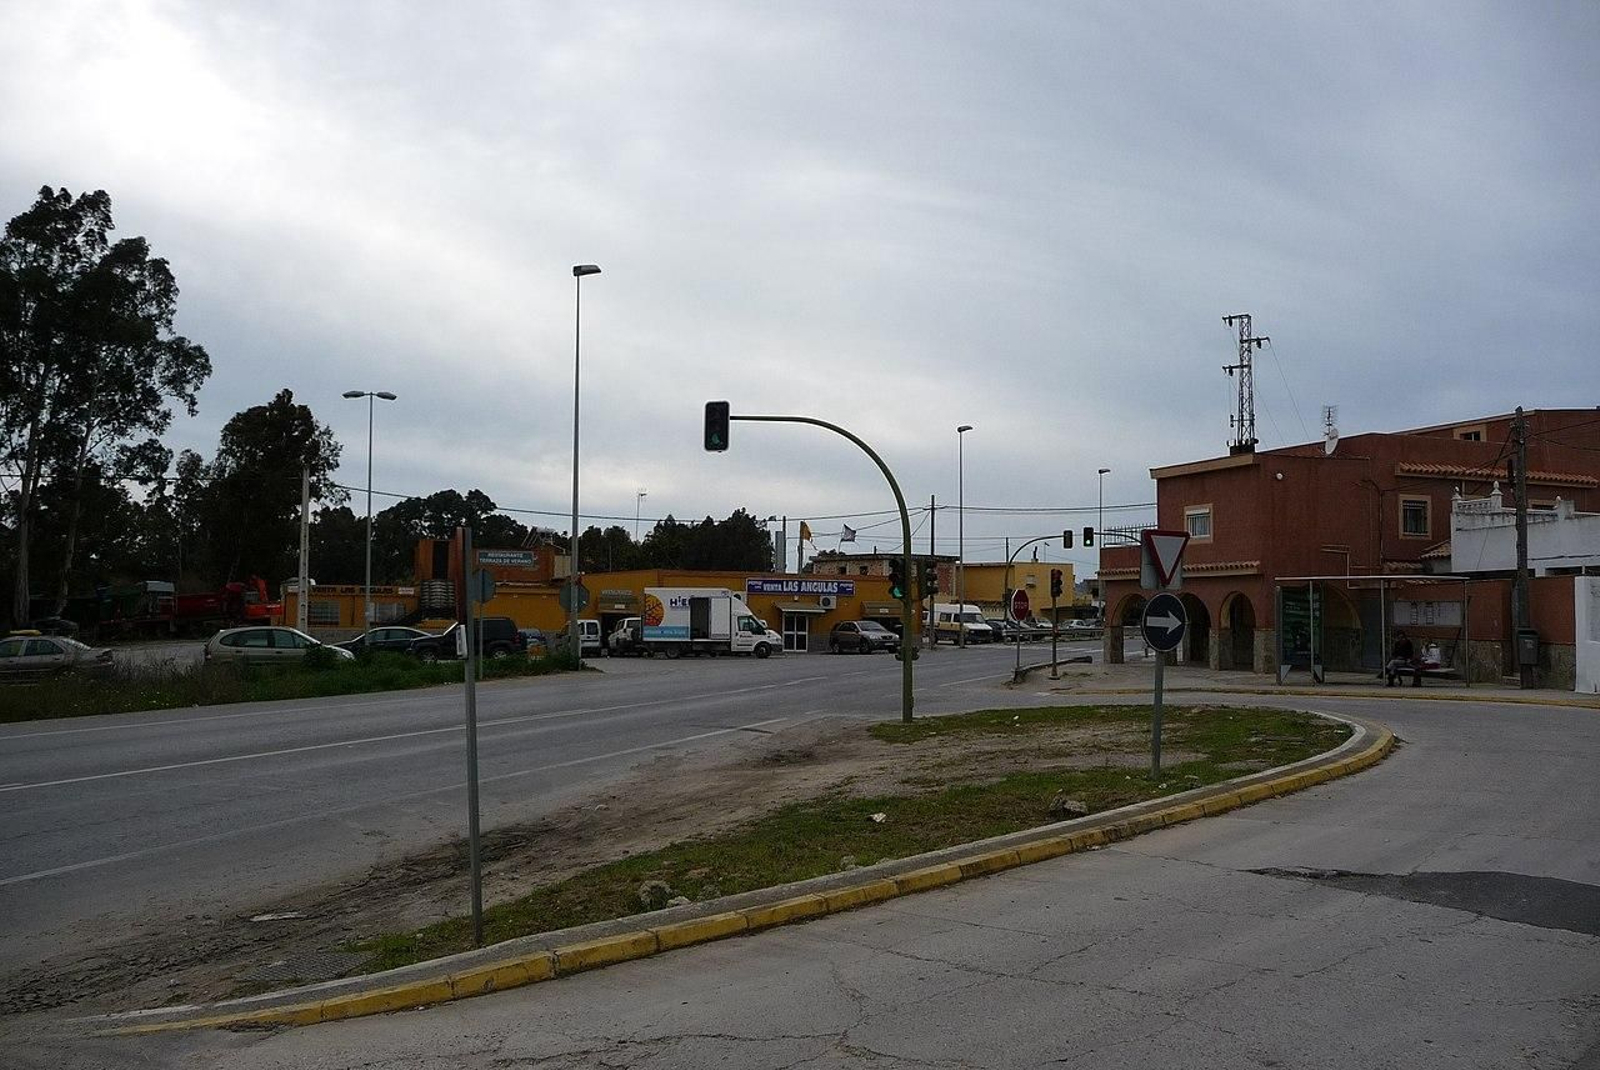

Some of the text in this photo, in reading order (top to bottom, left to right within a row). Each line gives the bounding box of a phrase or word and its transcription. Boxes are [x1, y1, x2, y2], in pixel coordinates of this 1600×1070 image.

[763, 583, 782, 591] VENTA
[783, 581, 799, 592] LAS
[800, 581, 839, 593] ANGULAS
